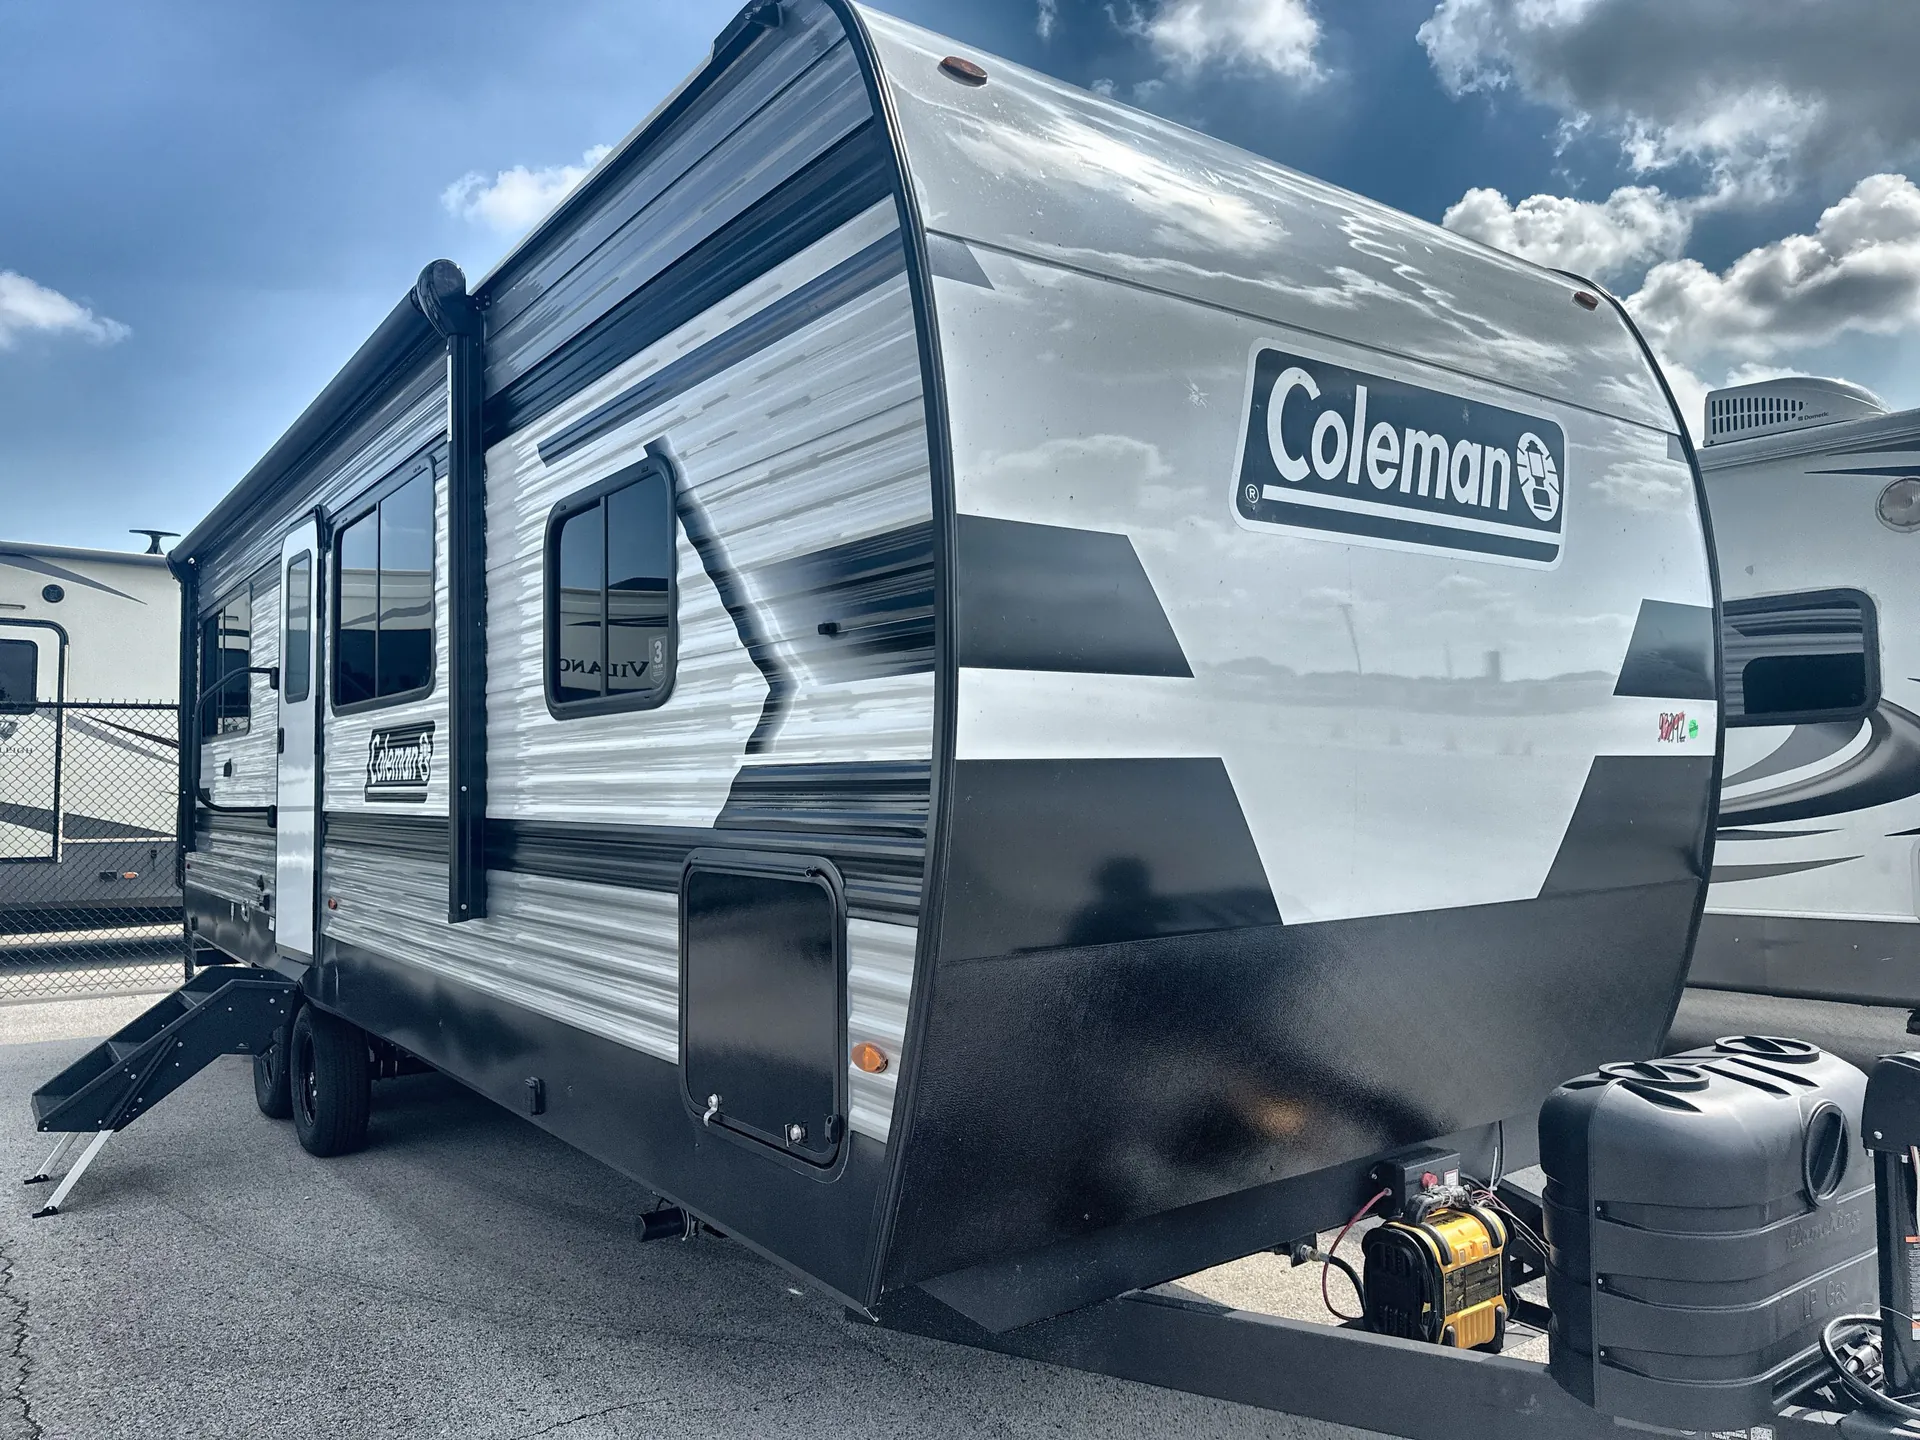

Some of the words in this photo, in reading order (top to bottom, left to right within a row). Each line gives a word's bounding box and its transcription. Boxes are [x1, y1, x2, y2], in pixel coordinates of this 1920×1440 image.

[1267, 367, 1511, 511] Coleman
[654, 640, 662, 664] 3
[370, 733, 418, 784] Coleman
